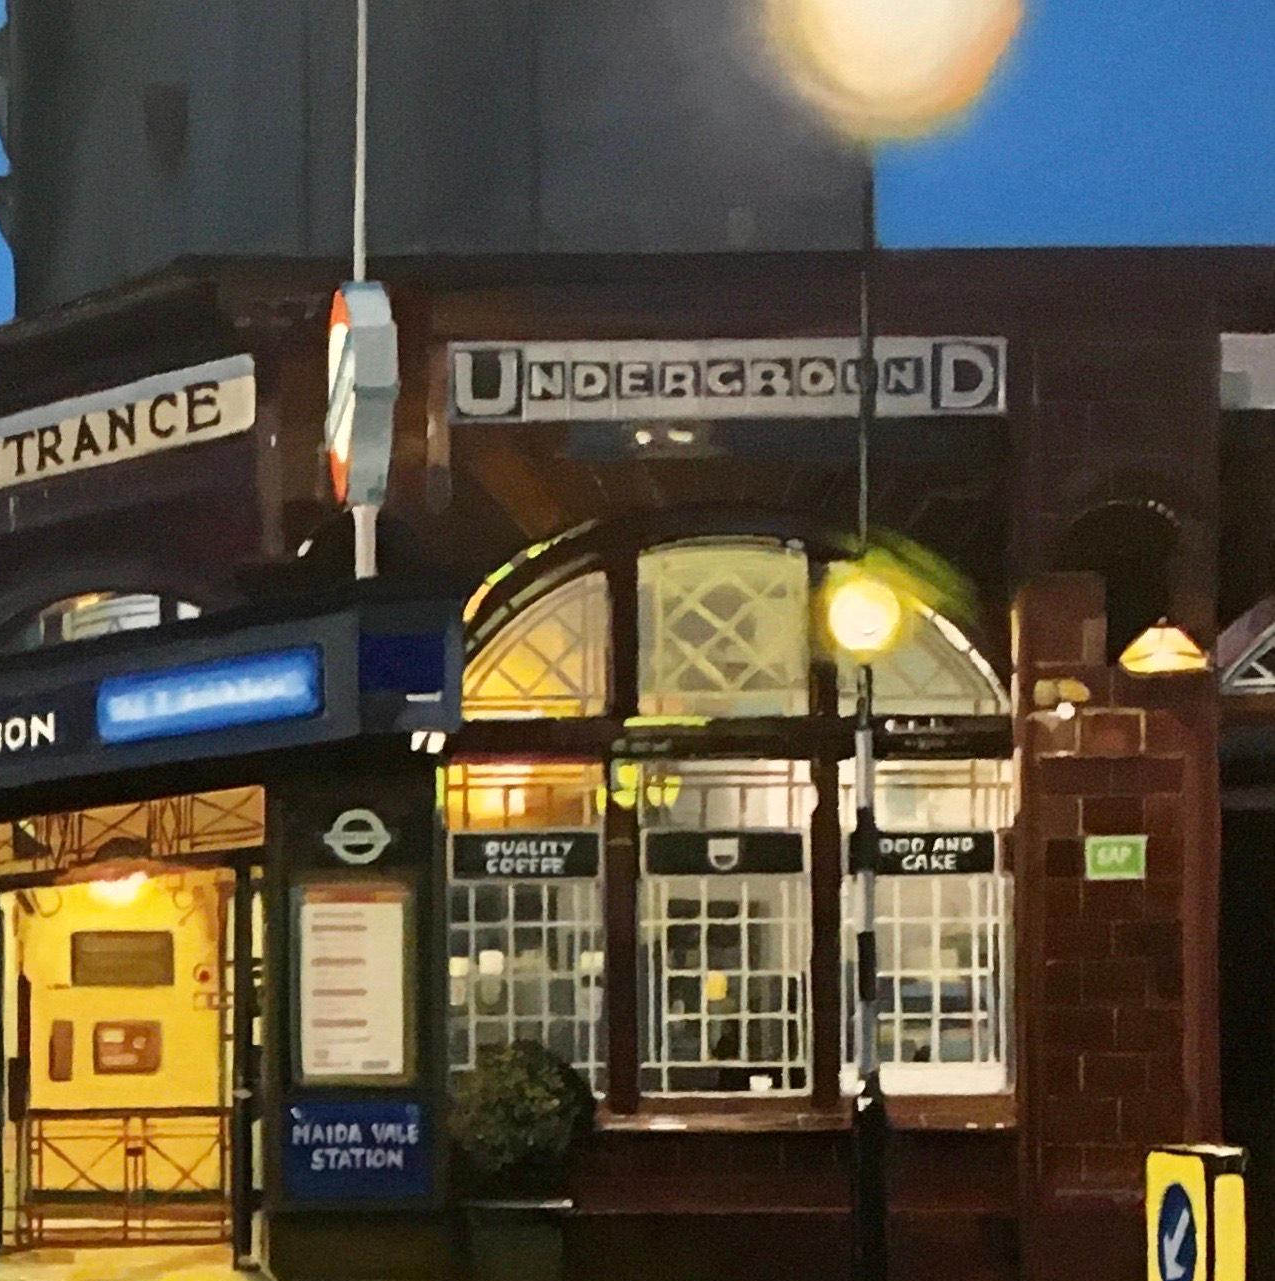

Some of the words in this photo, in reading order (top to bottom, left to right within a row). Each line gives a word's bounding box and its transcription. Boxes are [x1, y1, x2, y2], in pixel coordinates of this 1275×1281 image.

[484, 840, 574, 856] QUALITY
[932, 837, 976, 853] AND
[901, 854, 958, 870] CAKE
[292, 1122, 363, 1145] MAIDA
[371, 1122, 420, 1145] VALE
[311, 1147, 405, 1171] STATION
